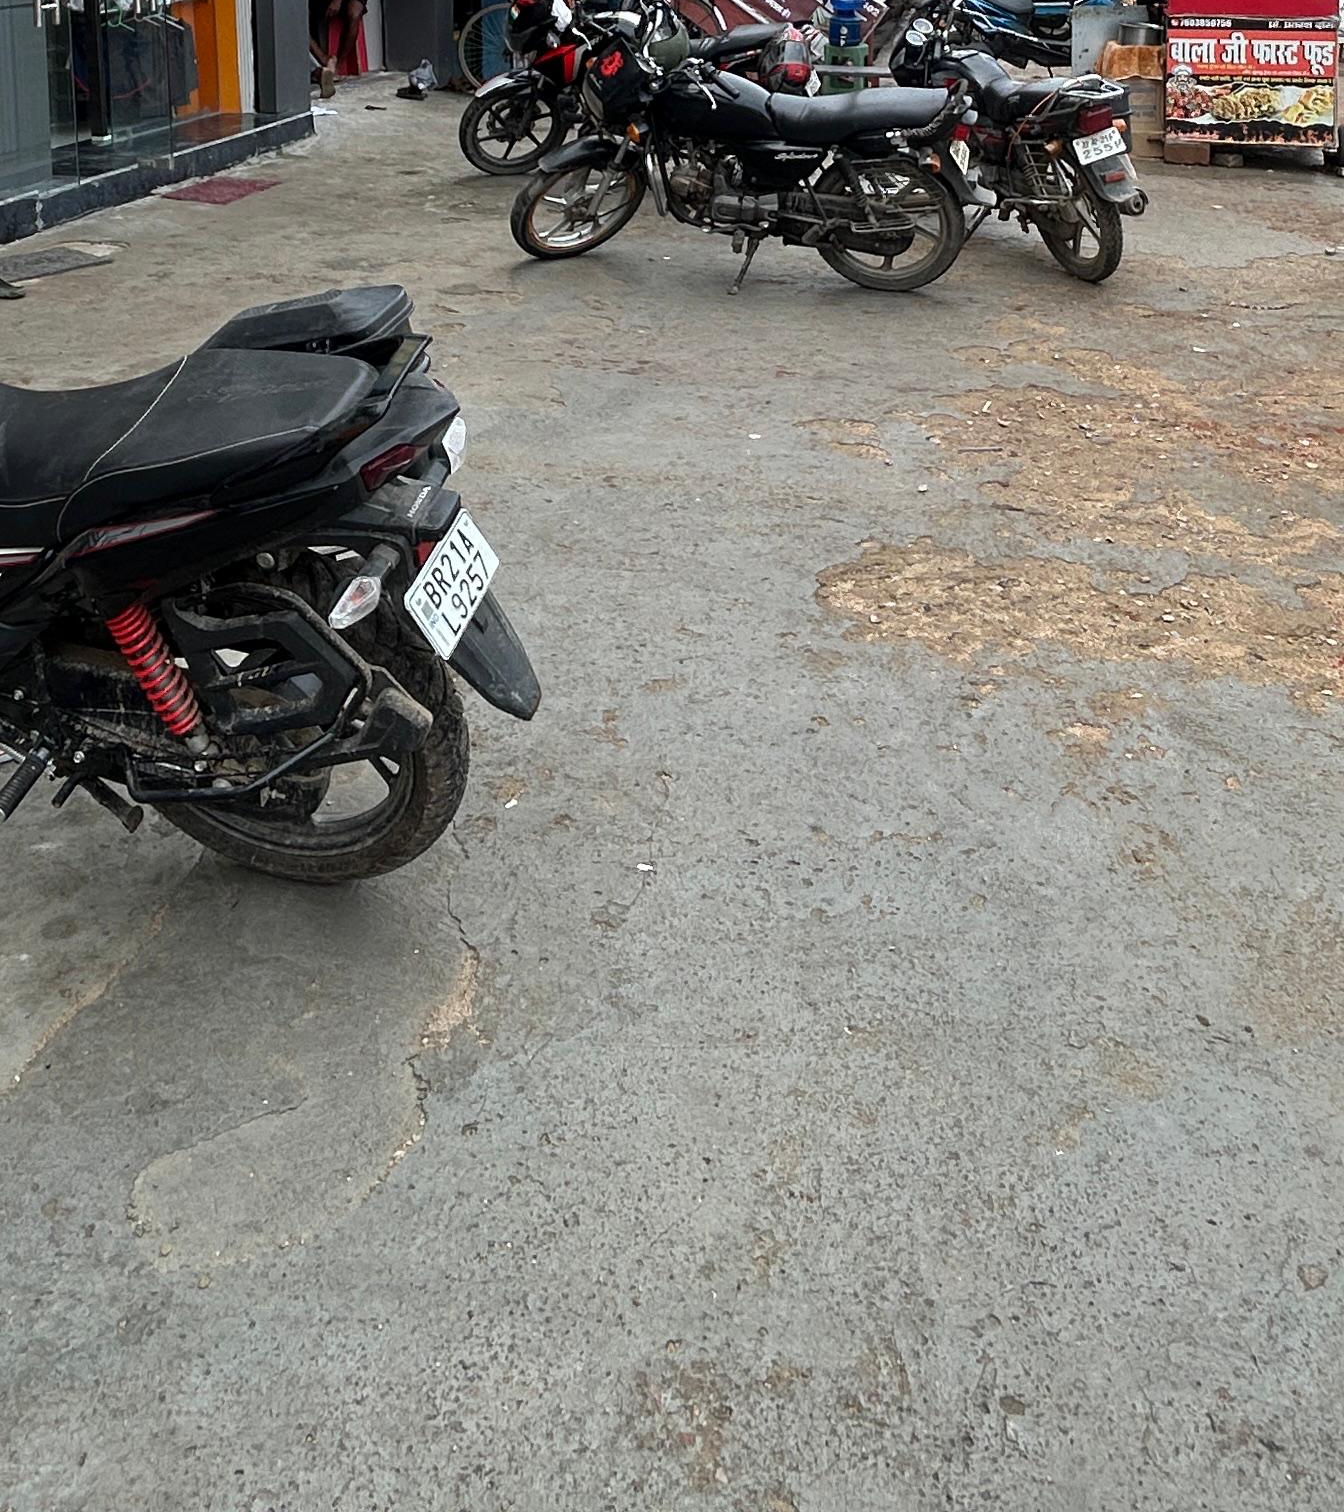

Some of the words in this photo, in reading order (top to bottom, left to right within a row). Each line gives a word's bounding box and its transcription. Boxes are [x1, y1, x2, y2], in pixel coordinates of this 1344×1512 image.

[1168, 37, 1218, 64] बाला
[1220, 31, 1249, 64] जी
[1251, 39, 1300, 65] फास्ट
[406, 486, 432, 519] HONDA
[422, 528, 475, 609] BR21A
[441, 550, 489, 637] L9257
